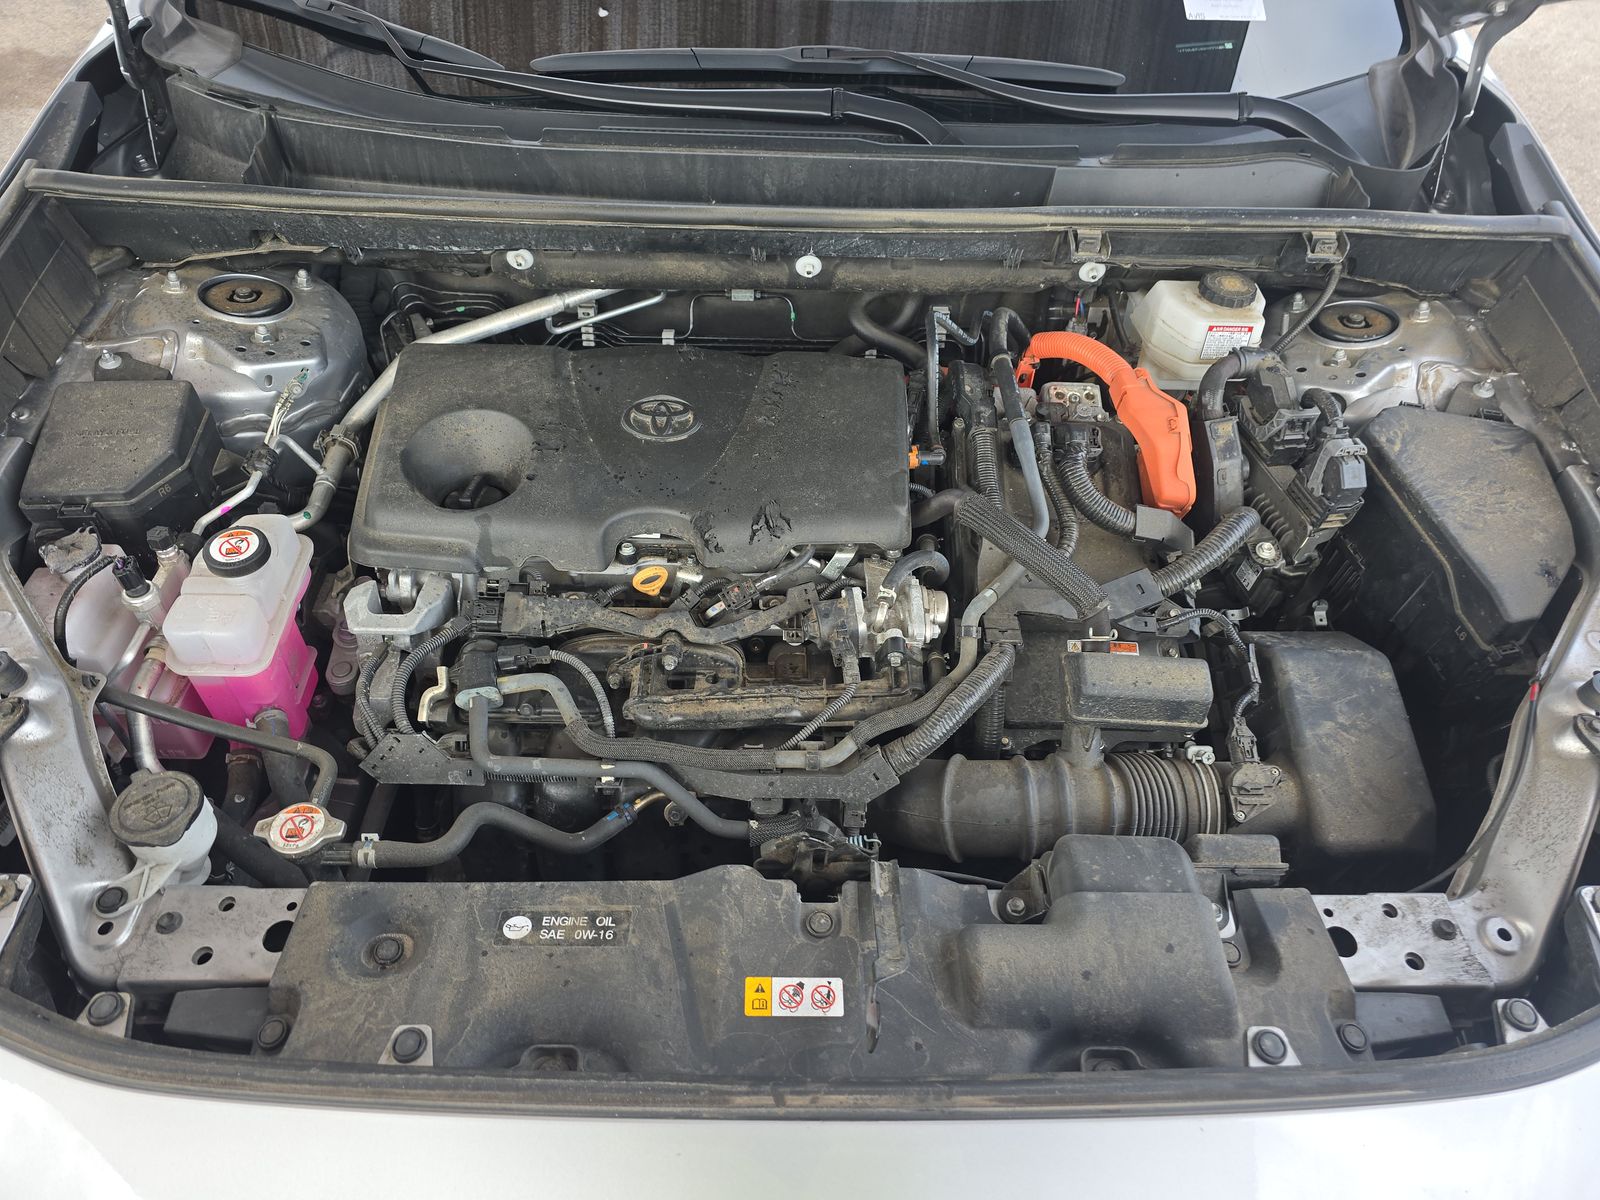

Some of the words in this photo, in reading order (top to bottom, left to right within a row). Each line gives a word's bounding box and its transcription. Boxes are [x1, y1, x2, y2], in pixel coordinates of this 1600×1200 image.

[158, 483, 171, 497] R6
[541, 916, 589, 927] ENGINE
[595, 916, 616, 927] OIL
[539, 929, 566, 940] SAE
[574, 929, 614, 940] 0W-16
